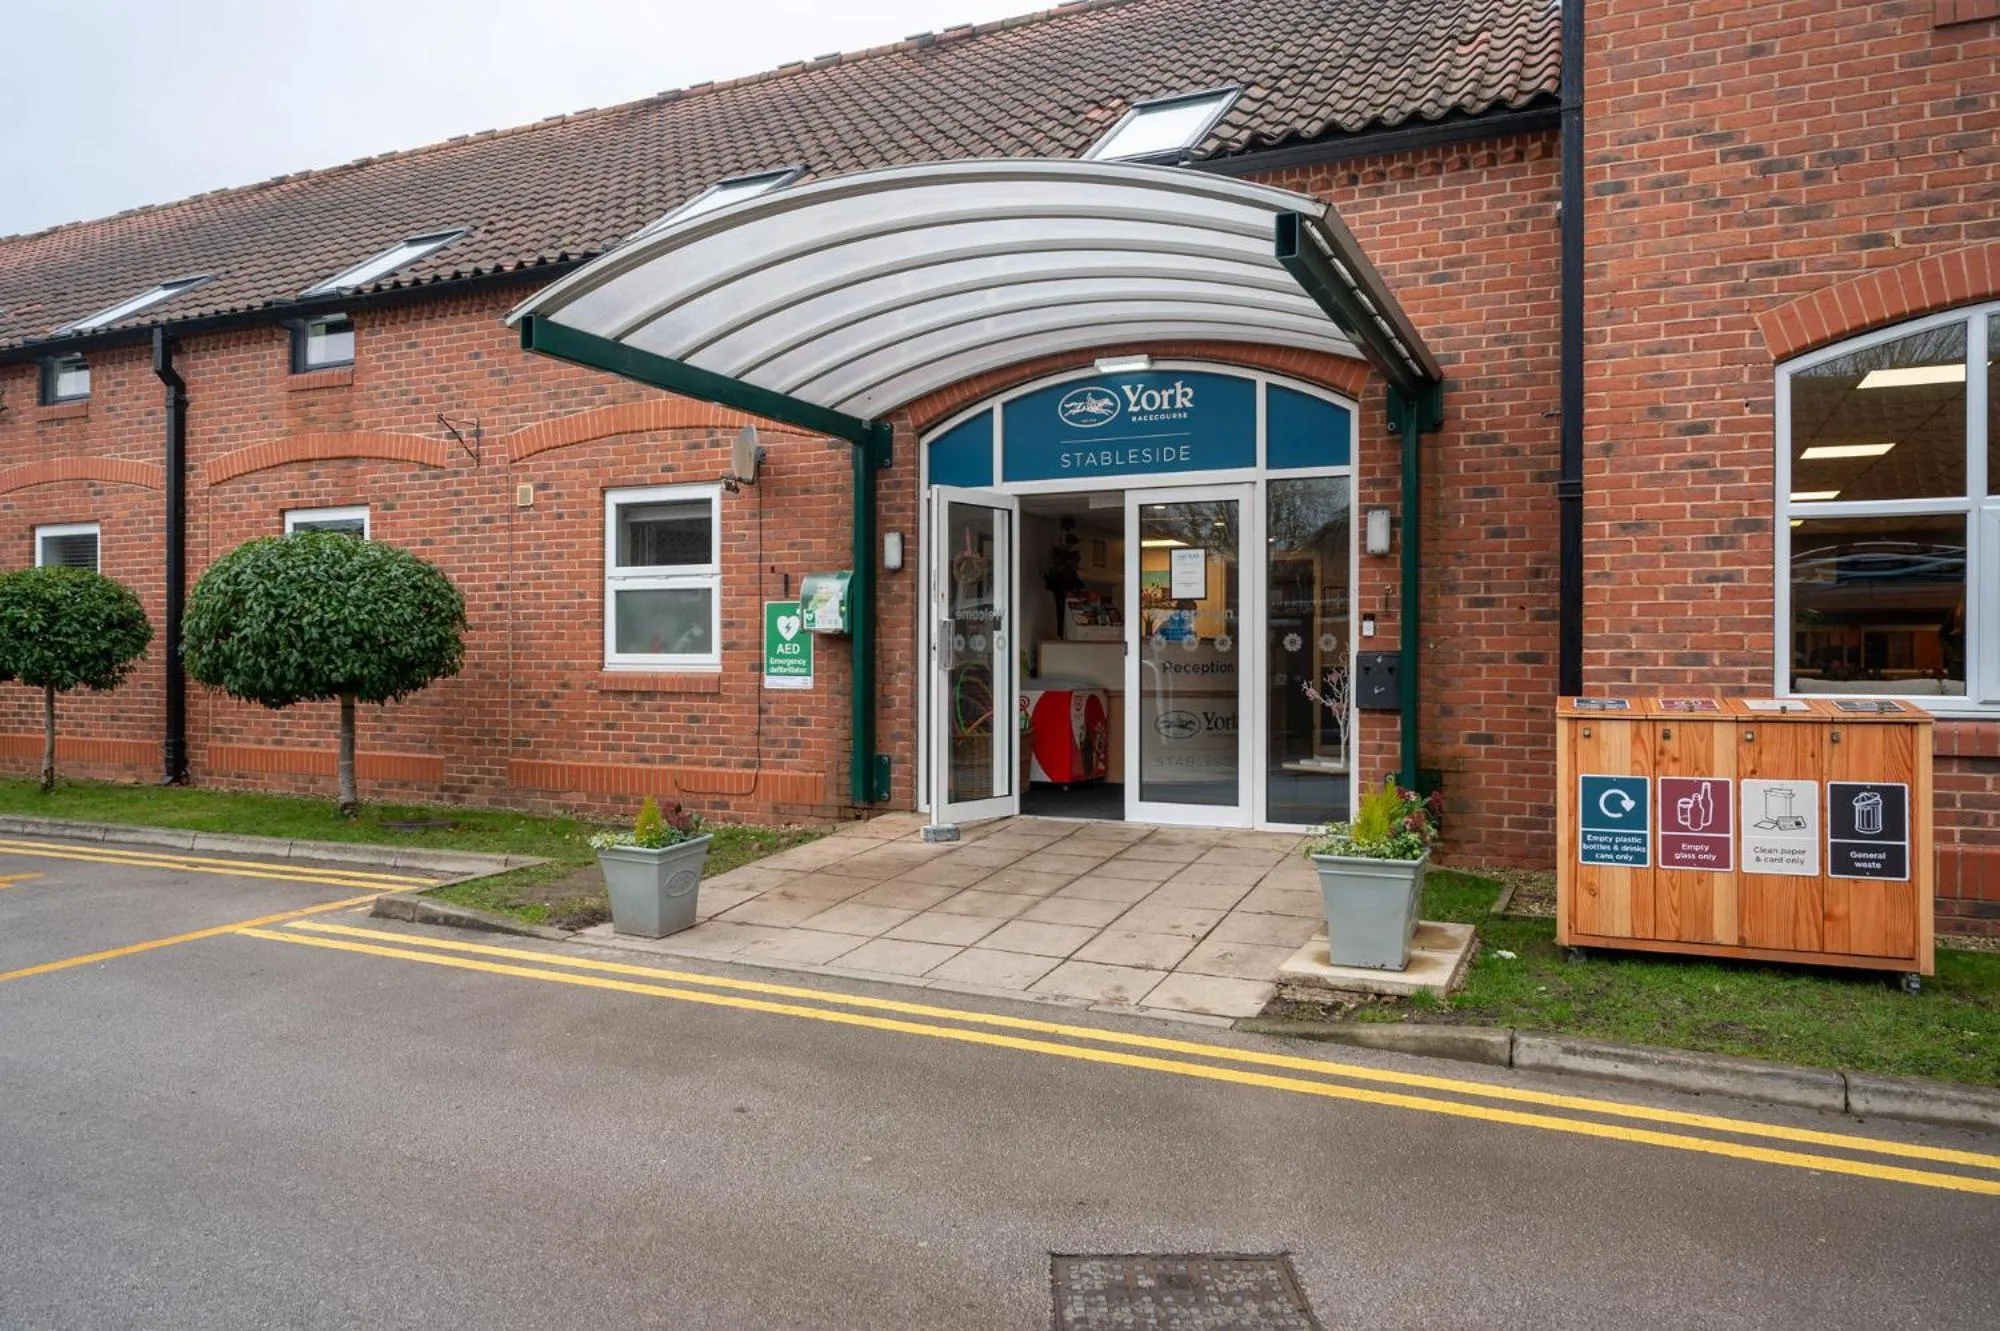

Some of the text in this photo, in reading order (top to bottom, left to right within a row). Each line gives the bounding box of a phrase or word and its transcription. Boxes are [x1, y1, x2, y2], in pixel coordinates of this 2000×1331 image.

[1121, 380, 1195, 412] York
[1131, 412, 1188, 422] RACECOURSE
[1060, 445, 1191, 468] STABLESIDE
[776, 643, 800, 654] AED
[770, 657, 806, 666] Emergency
[1162, 661, 1234, 674] Reception
[1587, 834, 1642, 844] Empty plastic
[1621, 845, 1646, 853] drinks
[1681, 843, 1710, 852] Empty
[1752, 846, 1807, 857] Clean paper
[1615, 854, 1633, 862] only
[1674, 852, 1717, 862] glass only
[1764, 855, 1784, 864] card
[1786, 856, 1805, 865] only
[1850, 851, 1886, 860] General
[1854, 861, 1882, 869] waste
